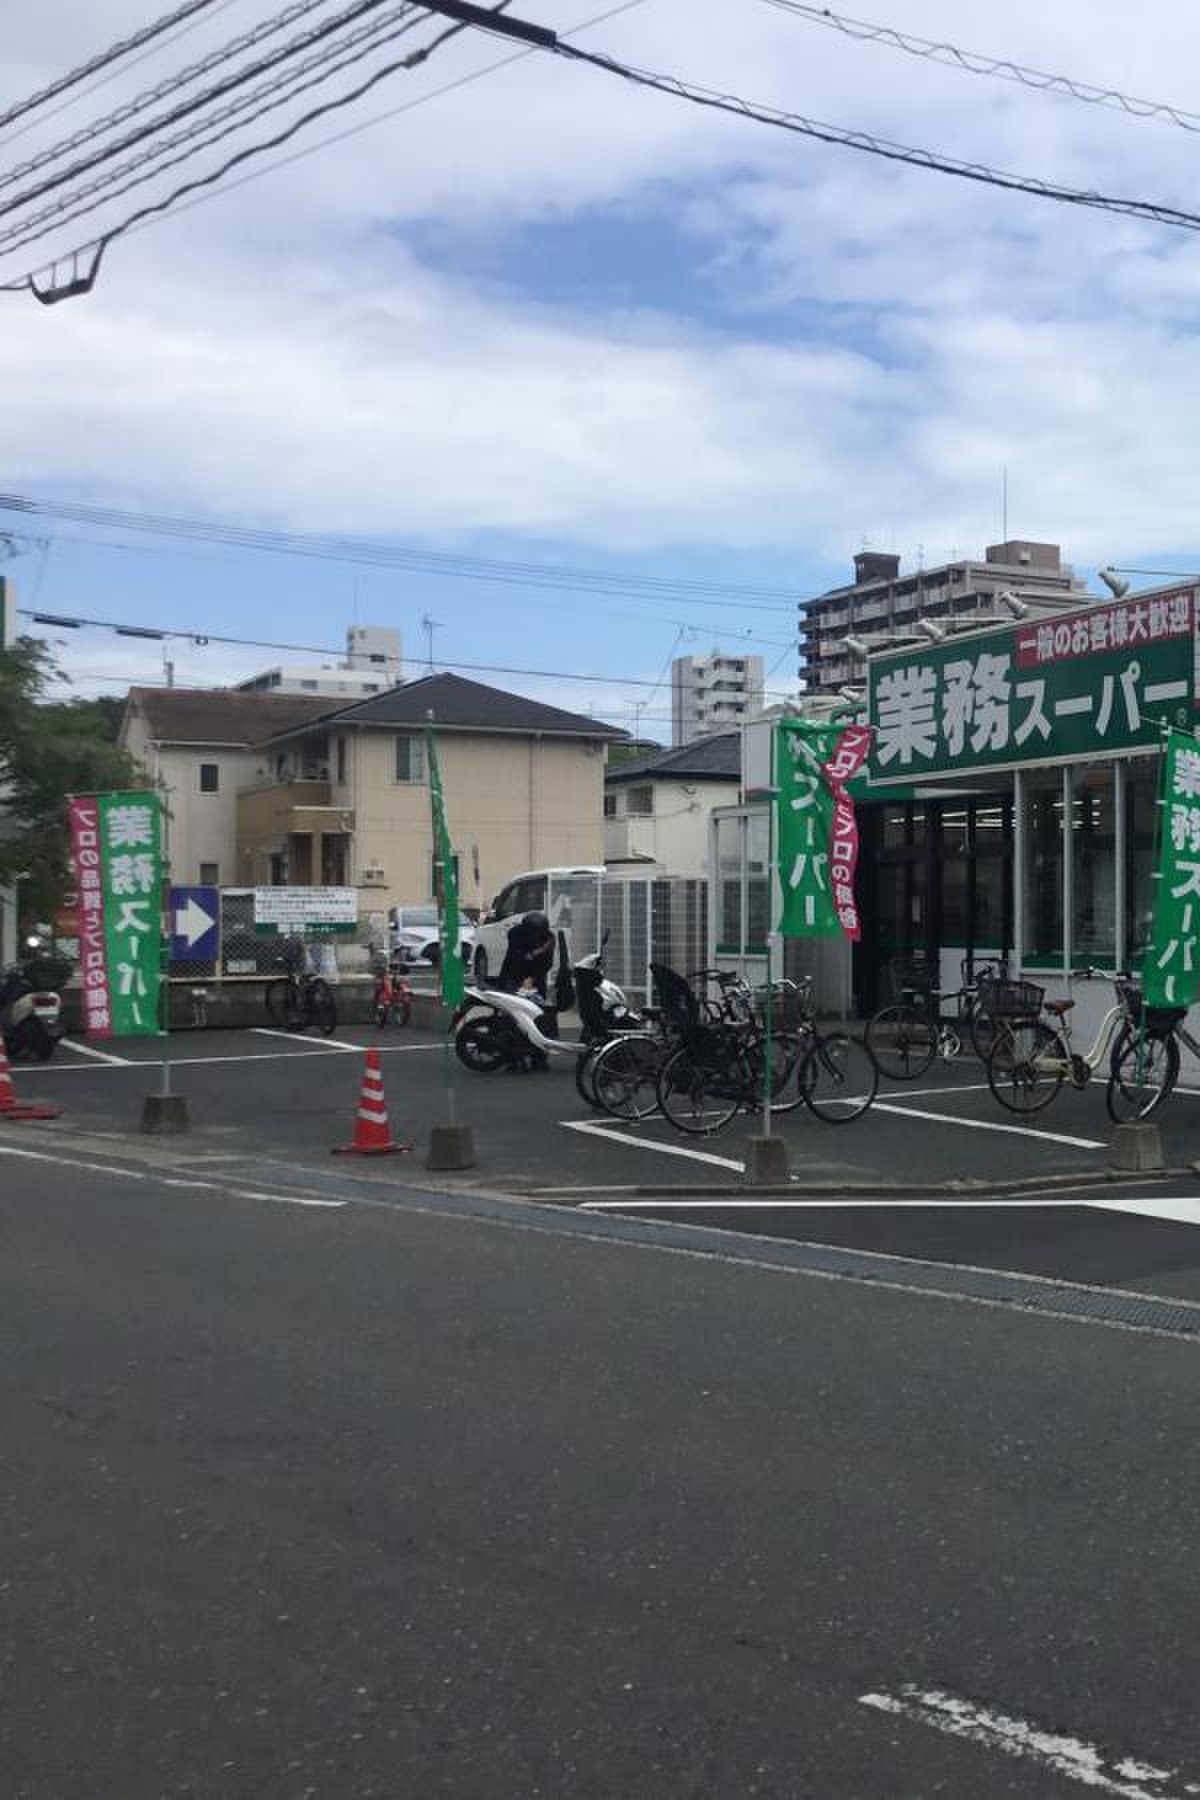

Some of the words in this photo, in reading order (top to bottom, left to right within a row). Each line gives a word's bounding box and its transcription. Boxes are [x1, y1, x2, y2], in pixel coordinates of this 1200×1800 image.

[875, 653, 1188, 767] 業務スーパー
